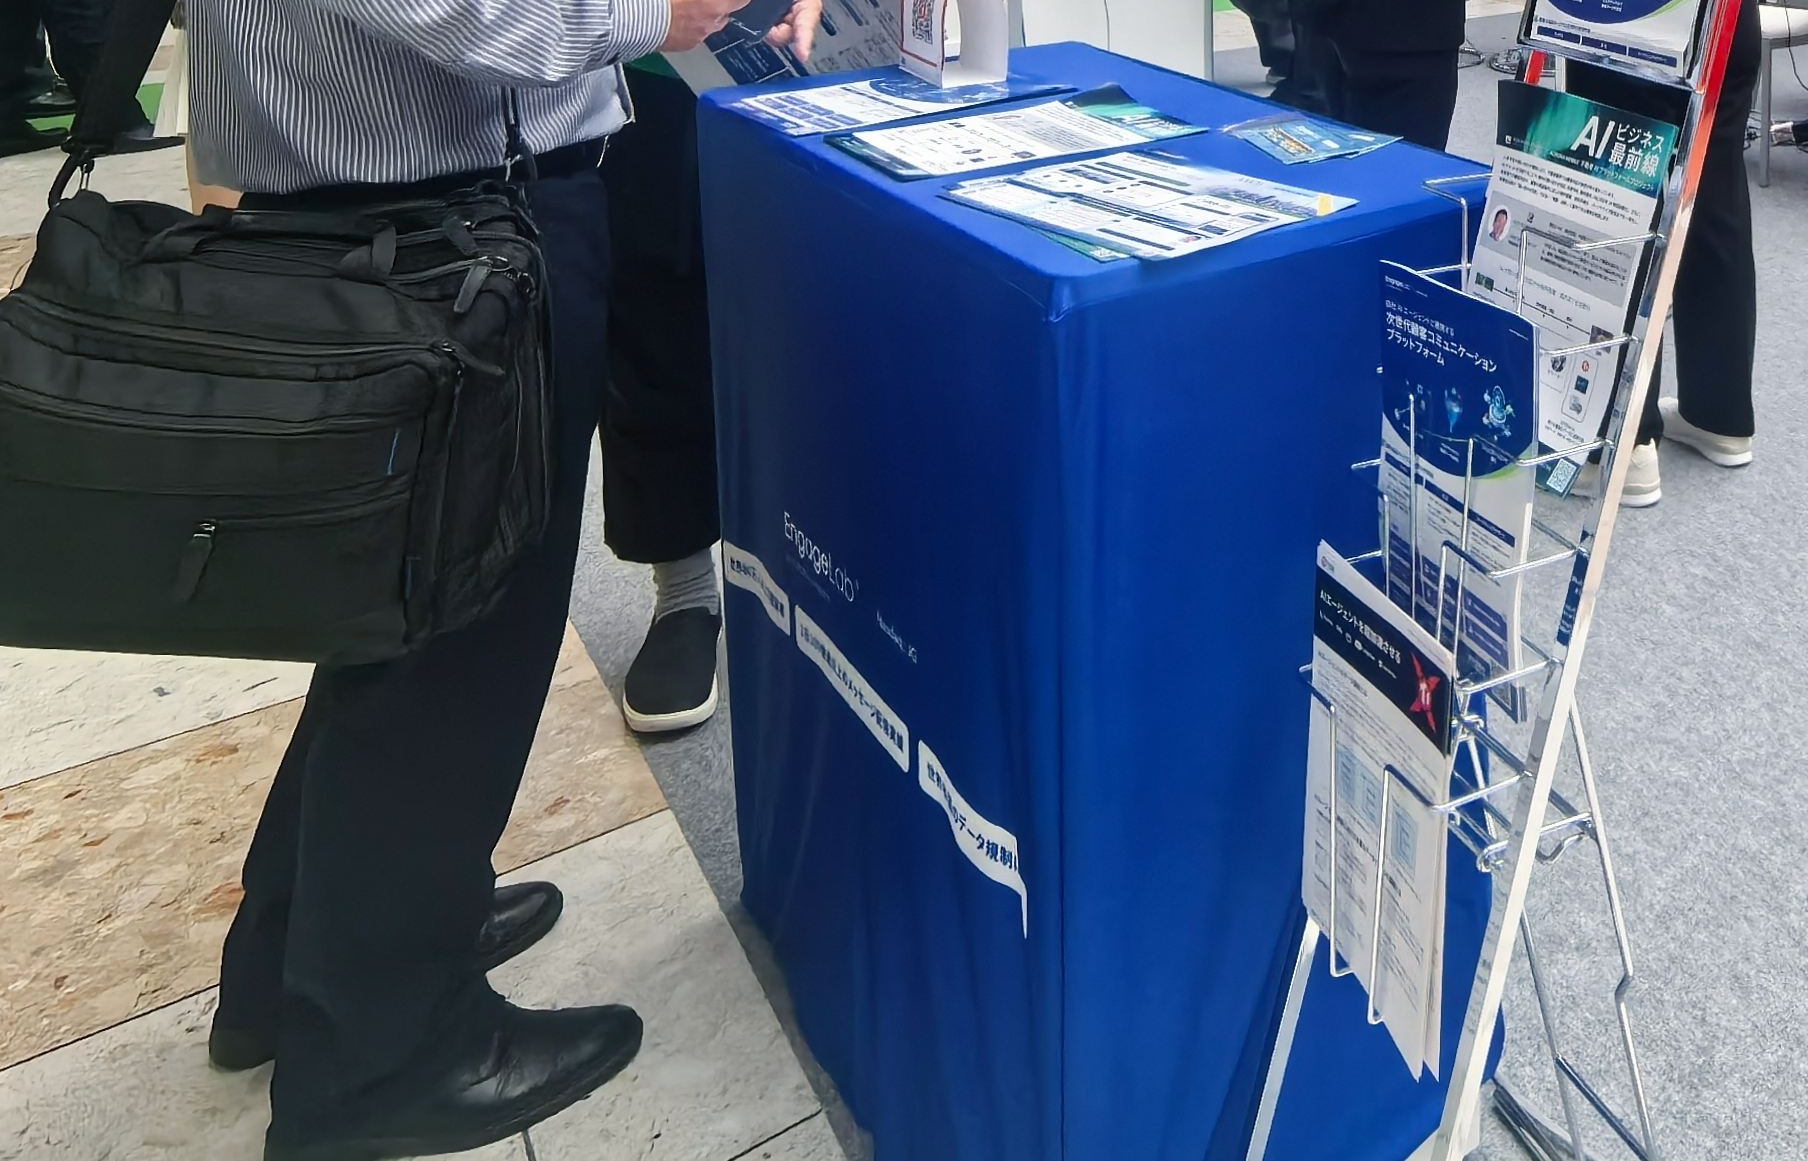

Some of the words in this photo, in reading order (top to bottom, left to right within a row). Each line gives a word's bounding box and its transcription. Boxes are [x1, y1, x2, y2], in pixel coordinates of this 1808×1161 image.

[1571, 116, 1615, 159] AI
[1617, 123, 1664, 152] ビジネス
[1609, 143, 1660, 178] 最前線
